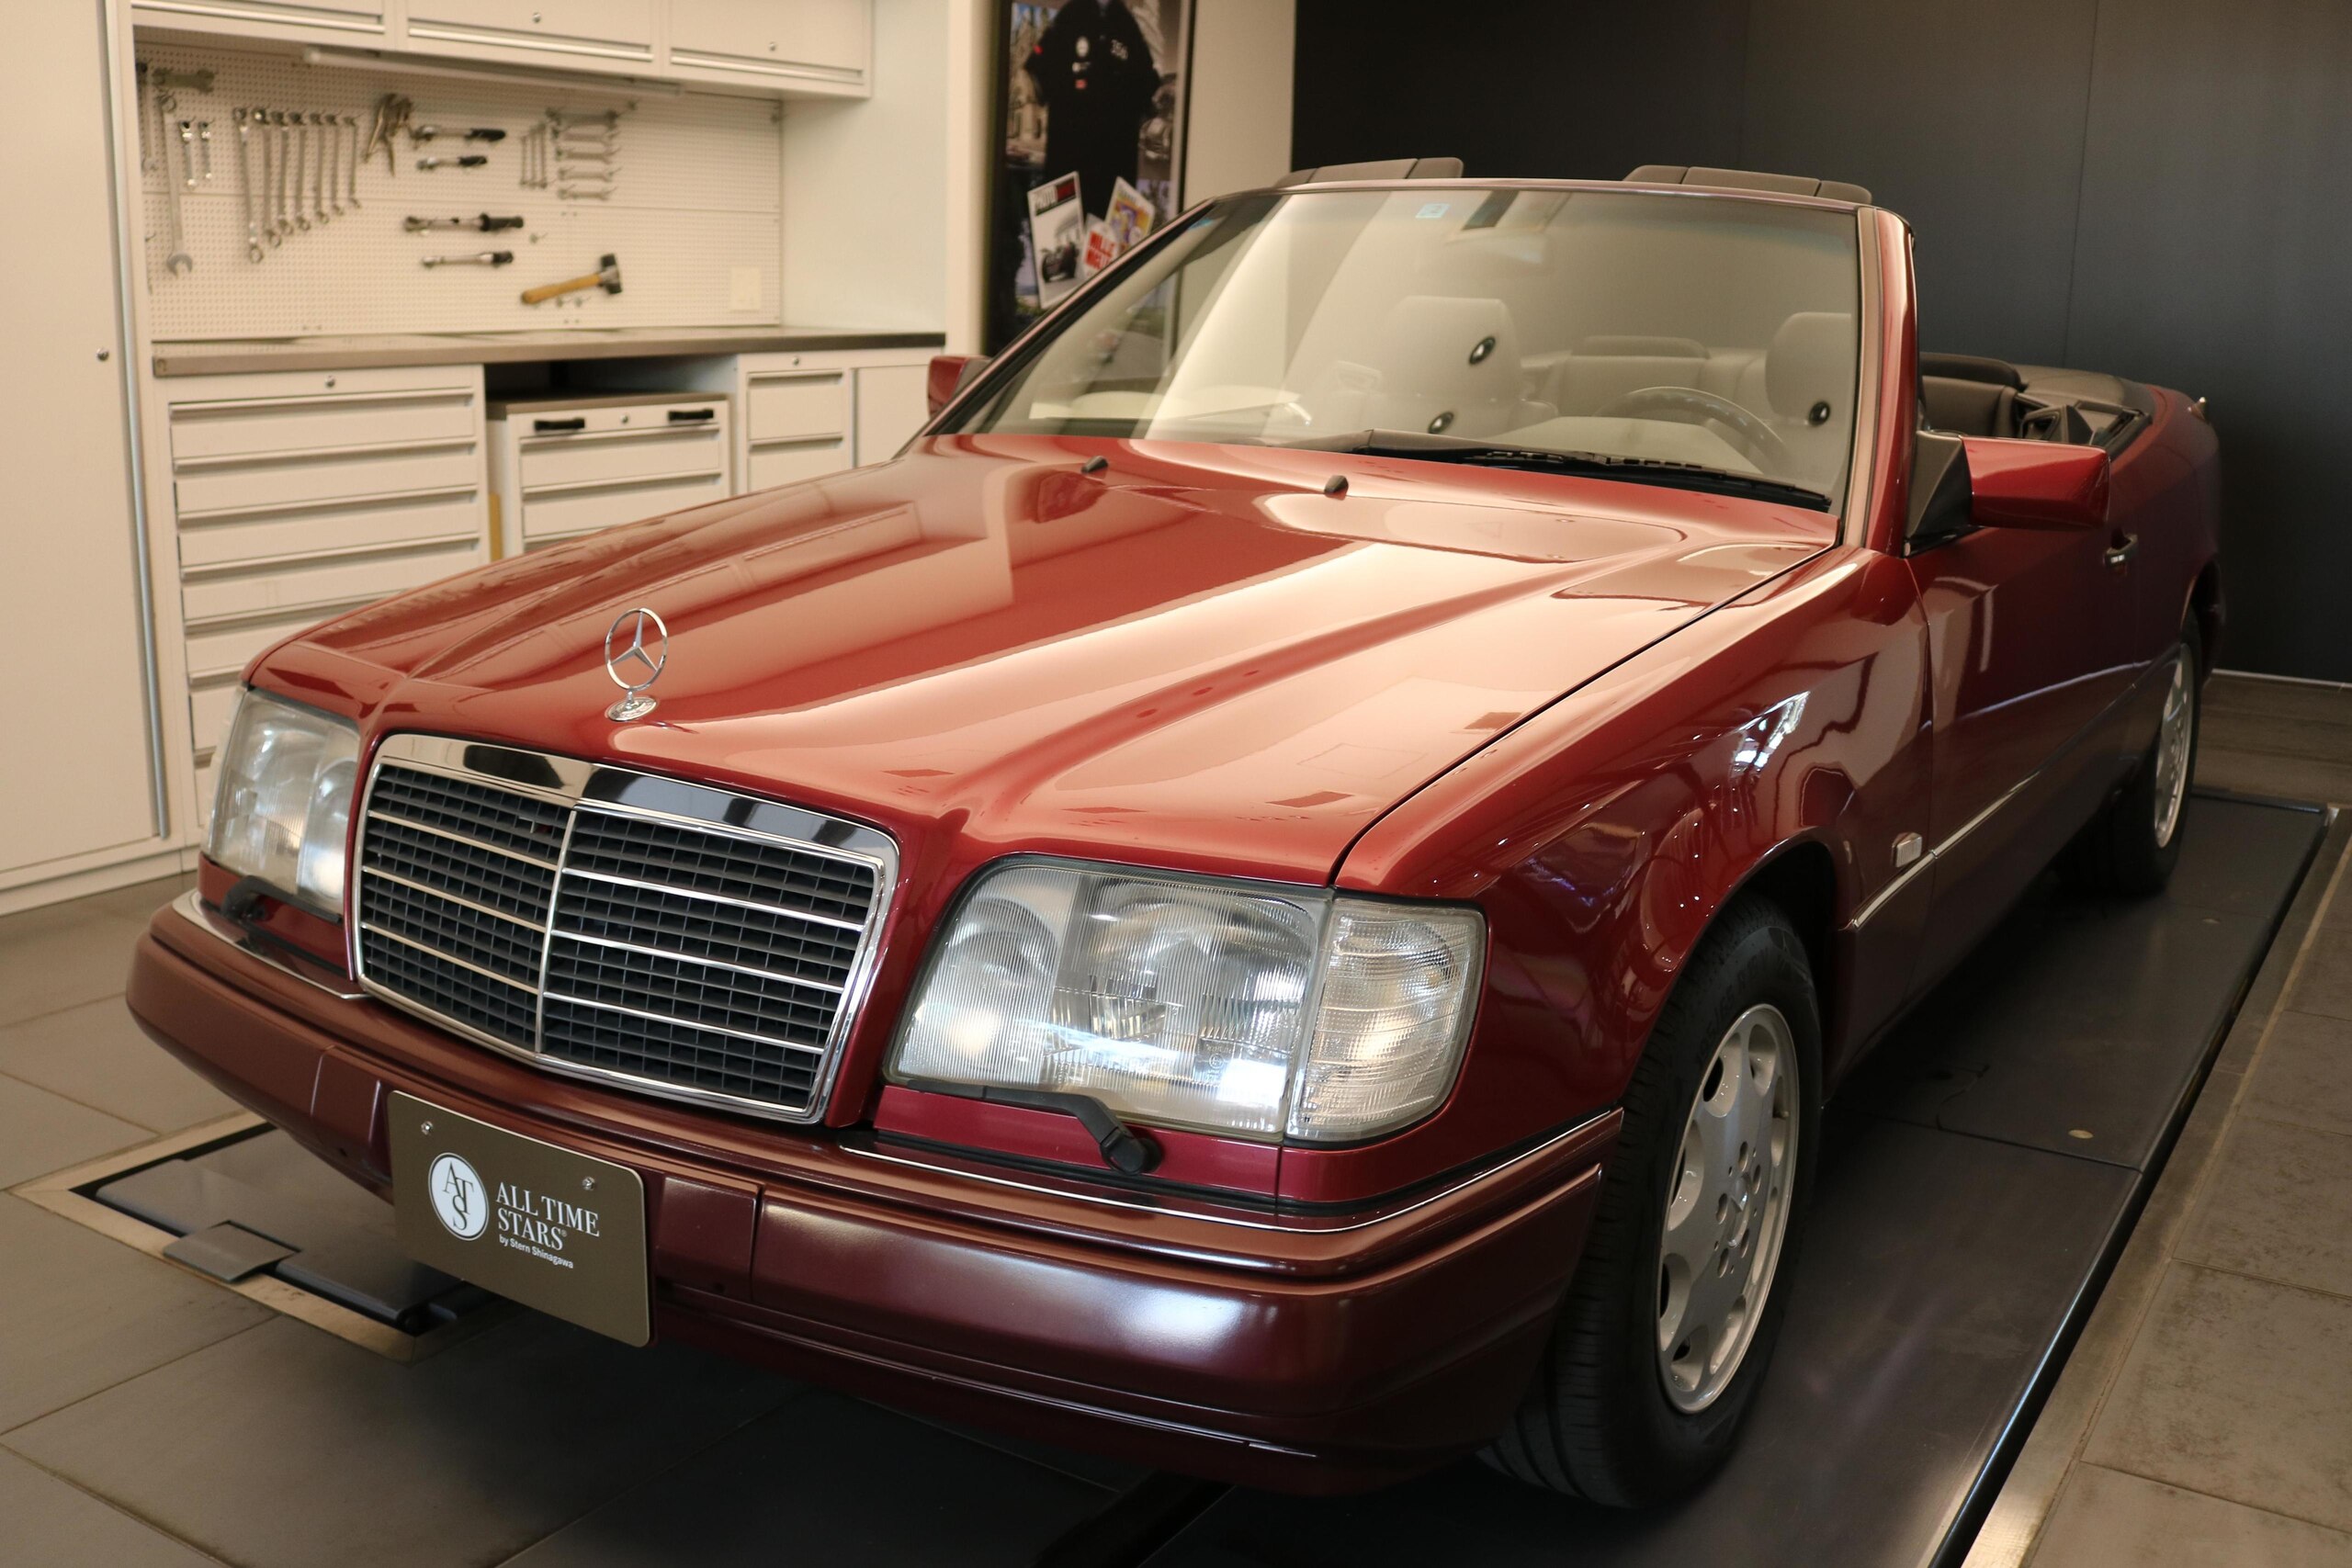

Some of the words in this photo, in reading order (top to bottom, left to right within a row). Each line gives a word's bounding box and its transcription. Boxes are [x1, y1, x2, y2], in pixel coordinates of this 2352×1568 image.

[496, 1181, 538, 1216] ALL
[540, 1195, 600, 1237] TIME
[499, 1234, 509, 1247] by
[510, 1237, 530, 1253] Stern
[532, 1246, 573, 1269] Shinagawa
